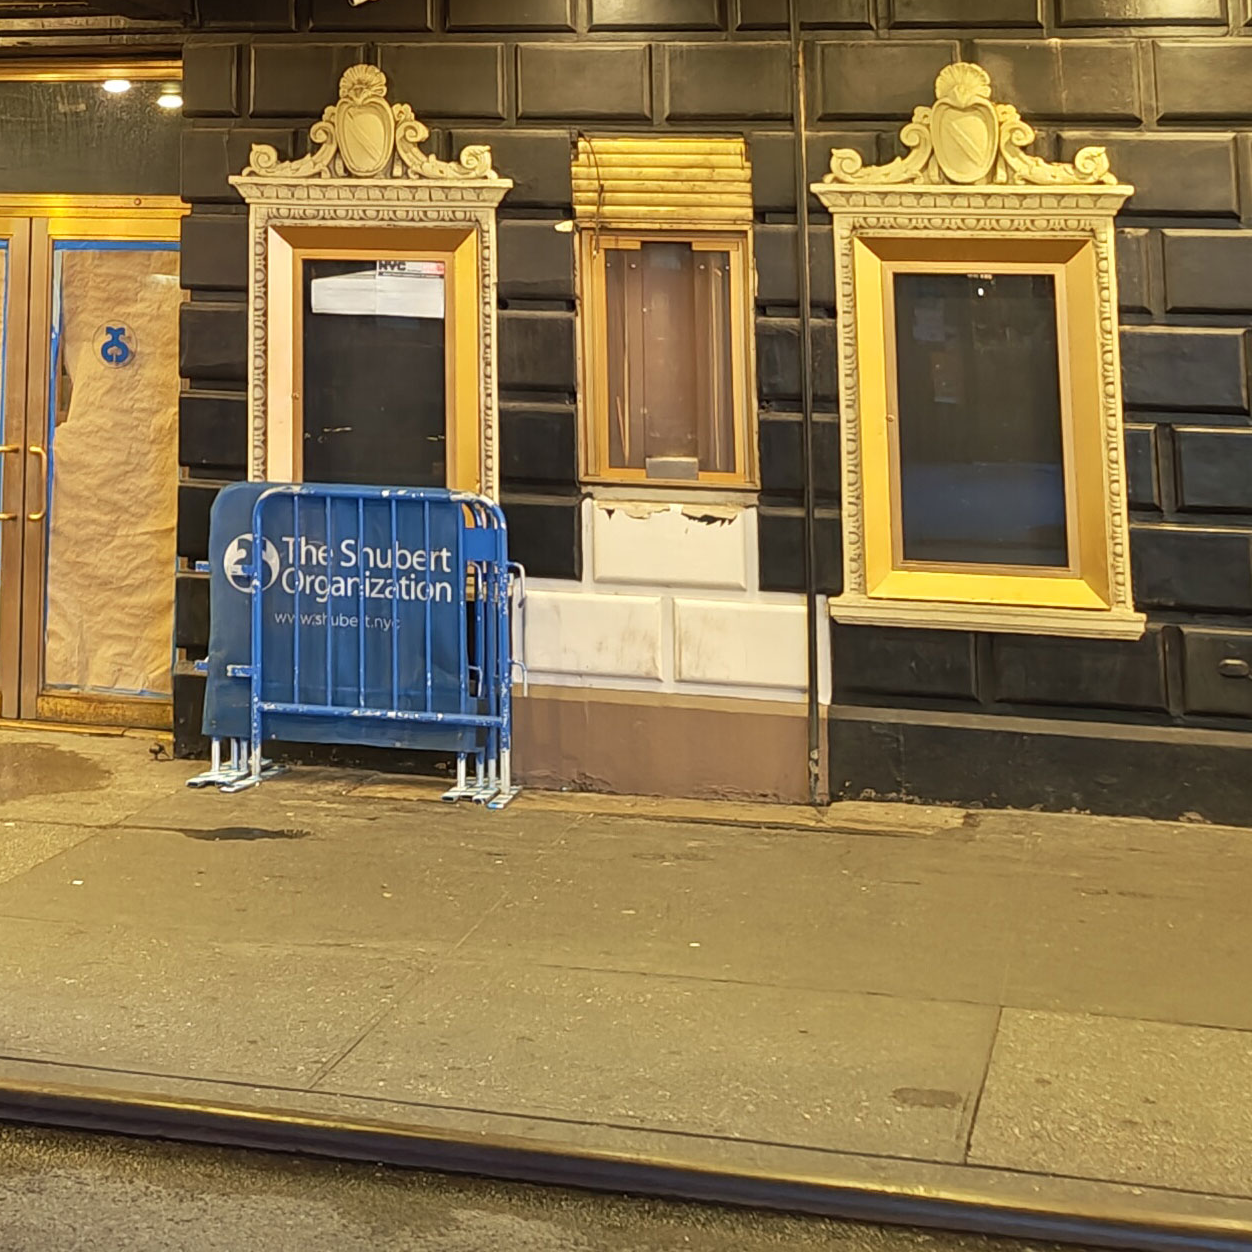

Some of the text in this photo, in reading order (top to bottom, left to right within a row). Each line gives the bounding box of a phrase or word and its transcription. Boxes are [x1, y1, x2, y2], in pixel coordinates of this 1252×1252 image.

[379, 260, 406, 271] NYC
[282, 536, 333, 566] The
[281, 567, 452, 603] Organization
